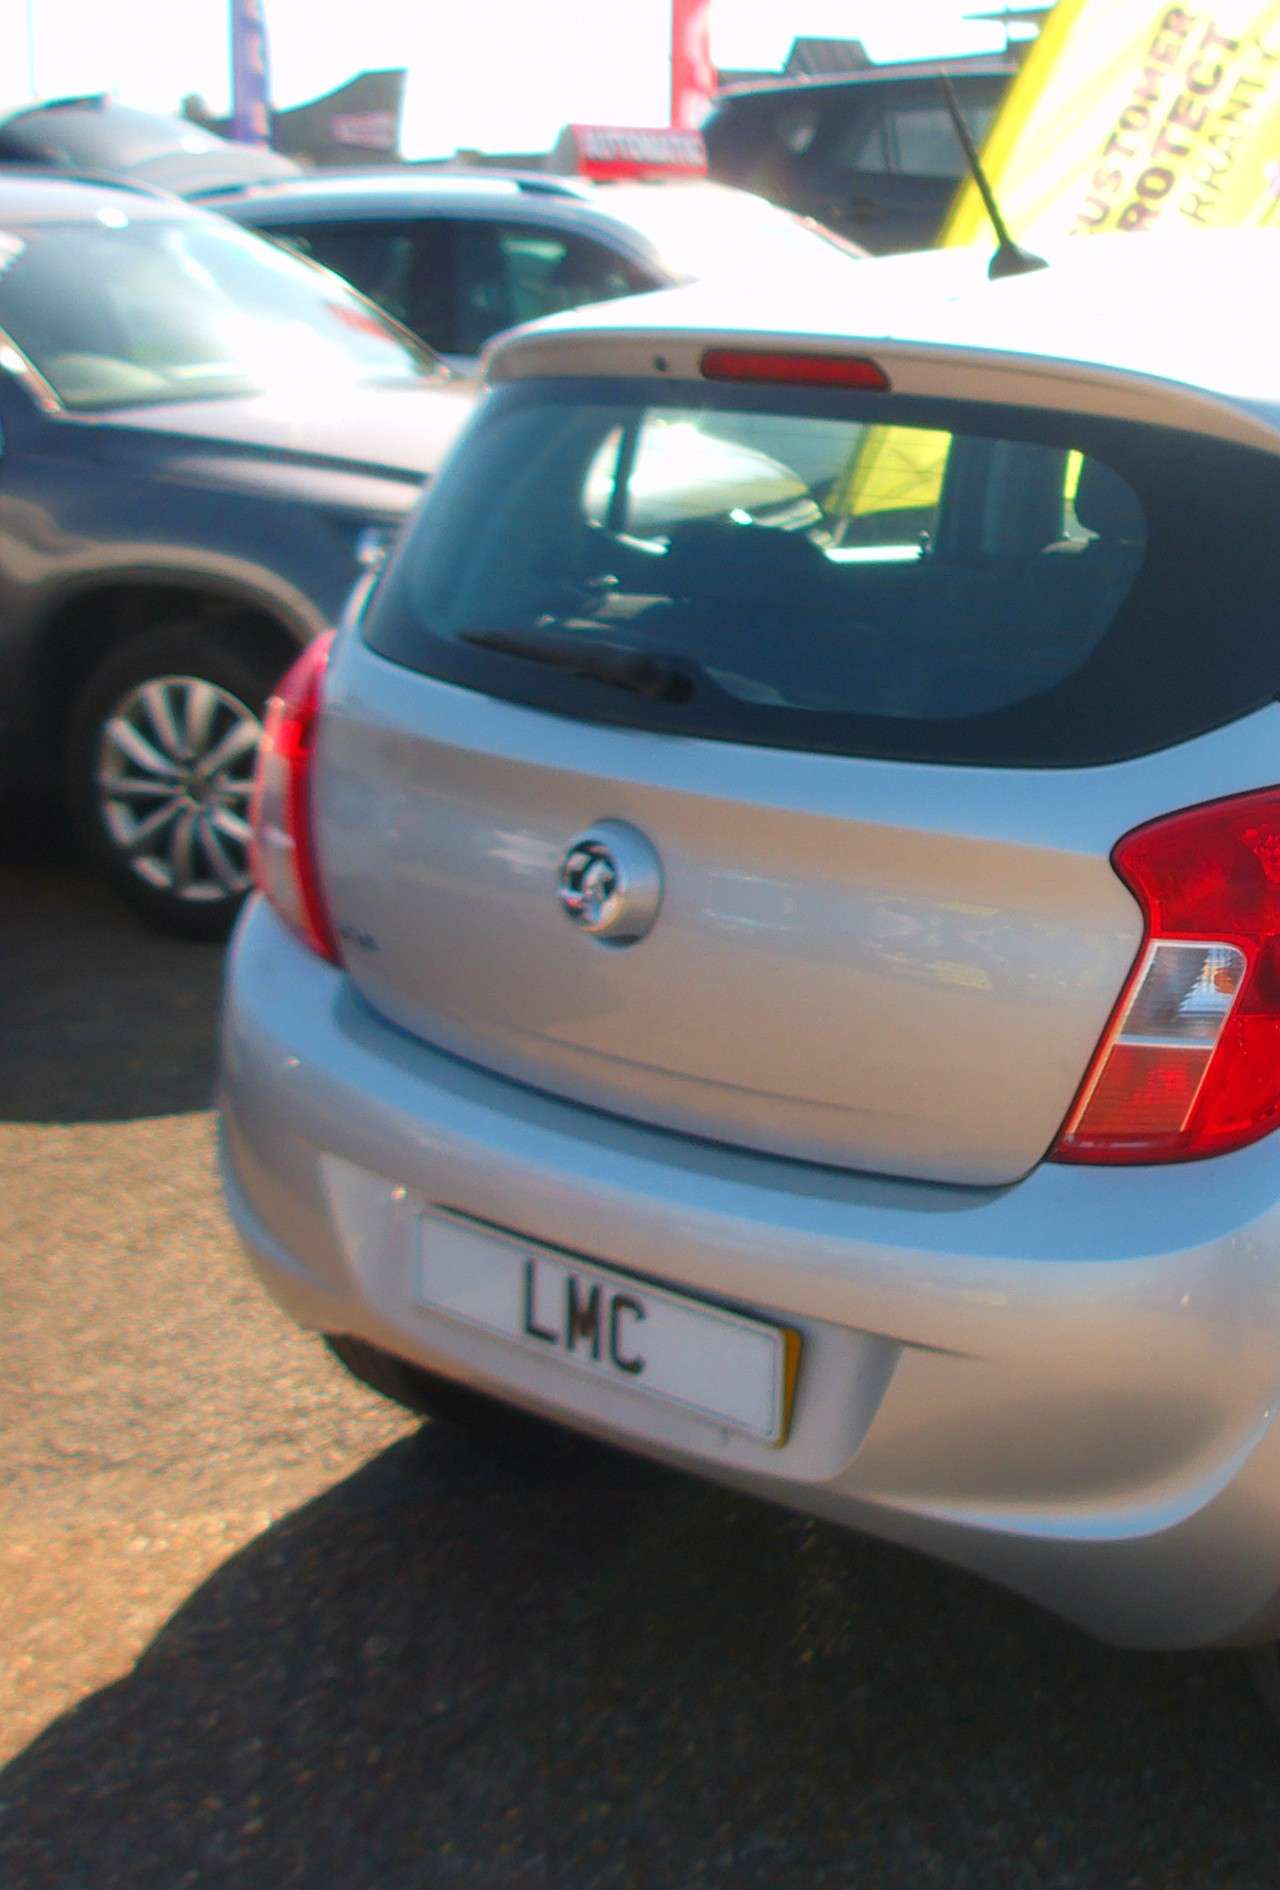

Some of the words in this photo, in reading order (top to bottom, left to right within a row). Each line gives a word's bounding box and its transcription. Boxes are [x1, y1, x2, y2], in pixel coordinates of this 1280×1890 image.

[1069, 8, 1196, 234] USTOMER
[1115, 20, 1239, 231] ROTECT
[522, 1256, 647, 1376] LMC
